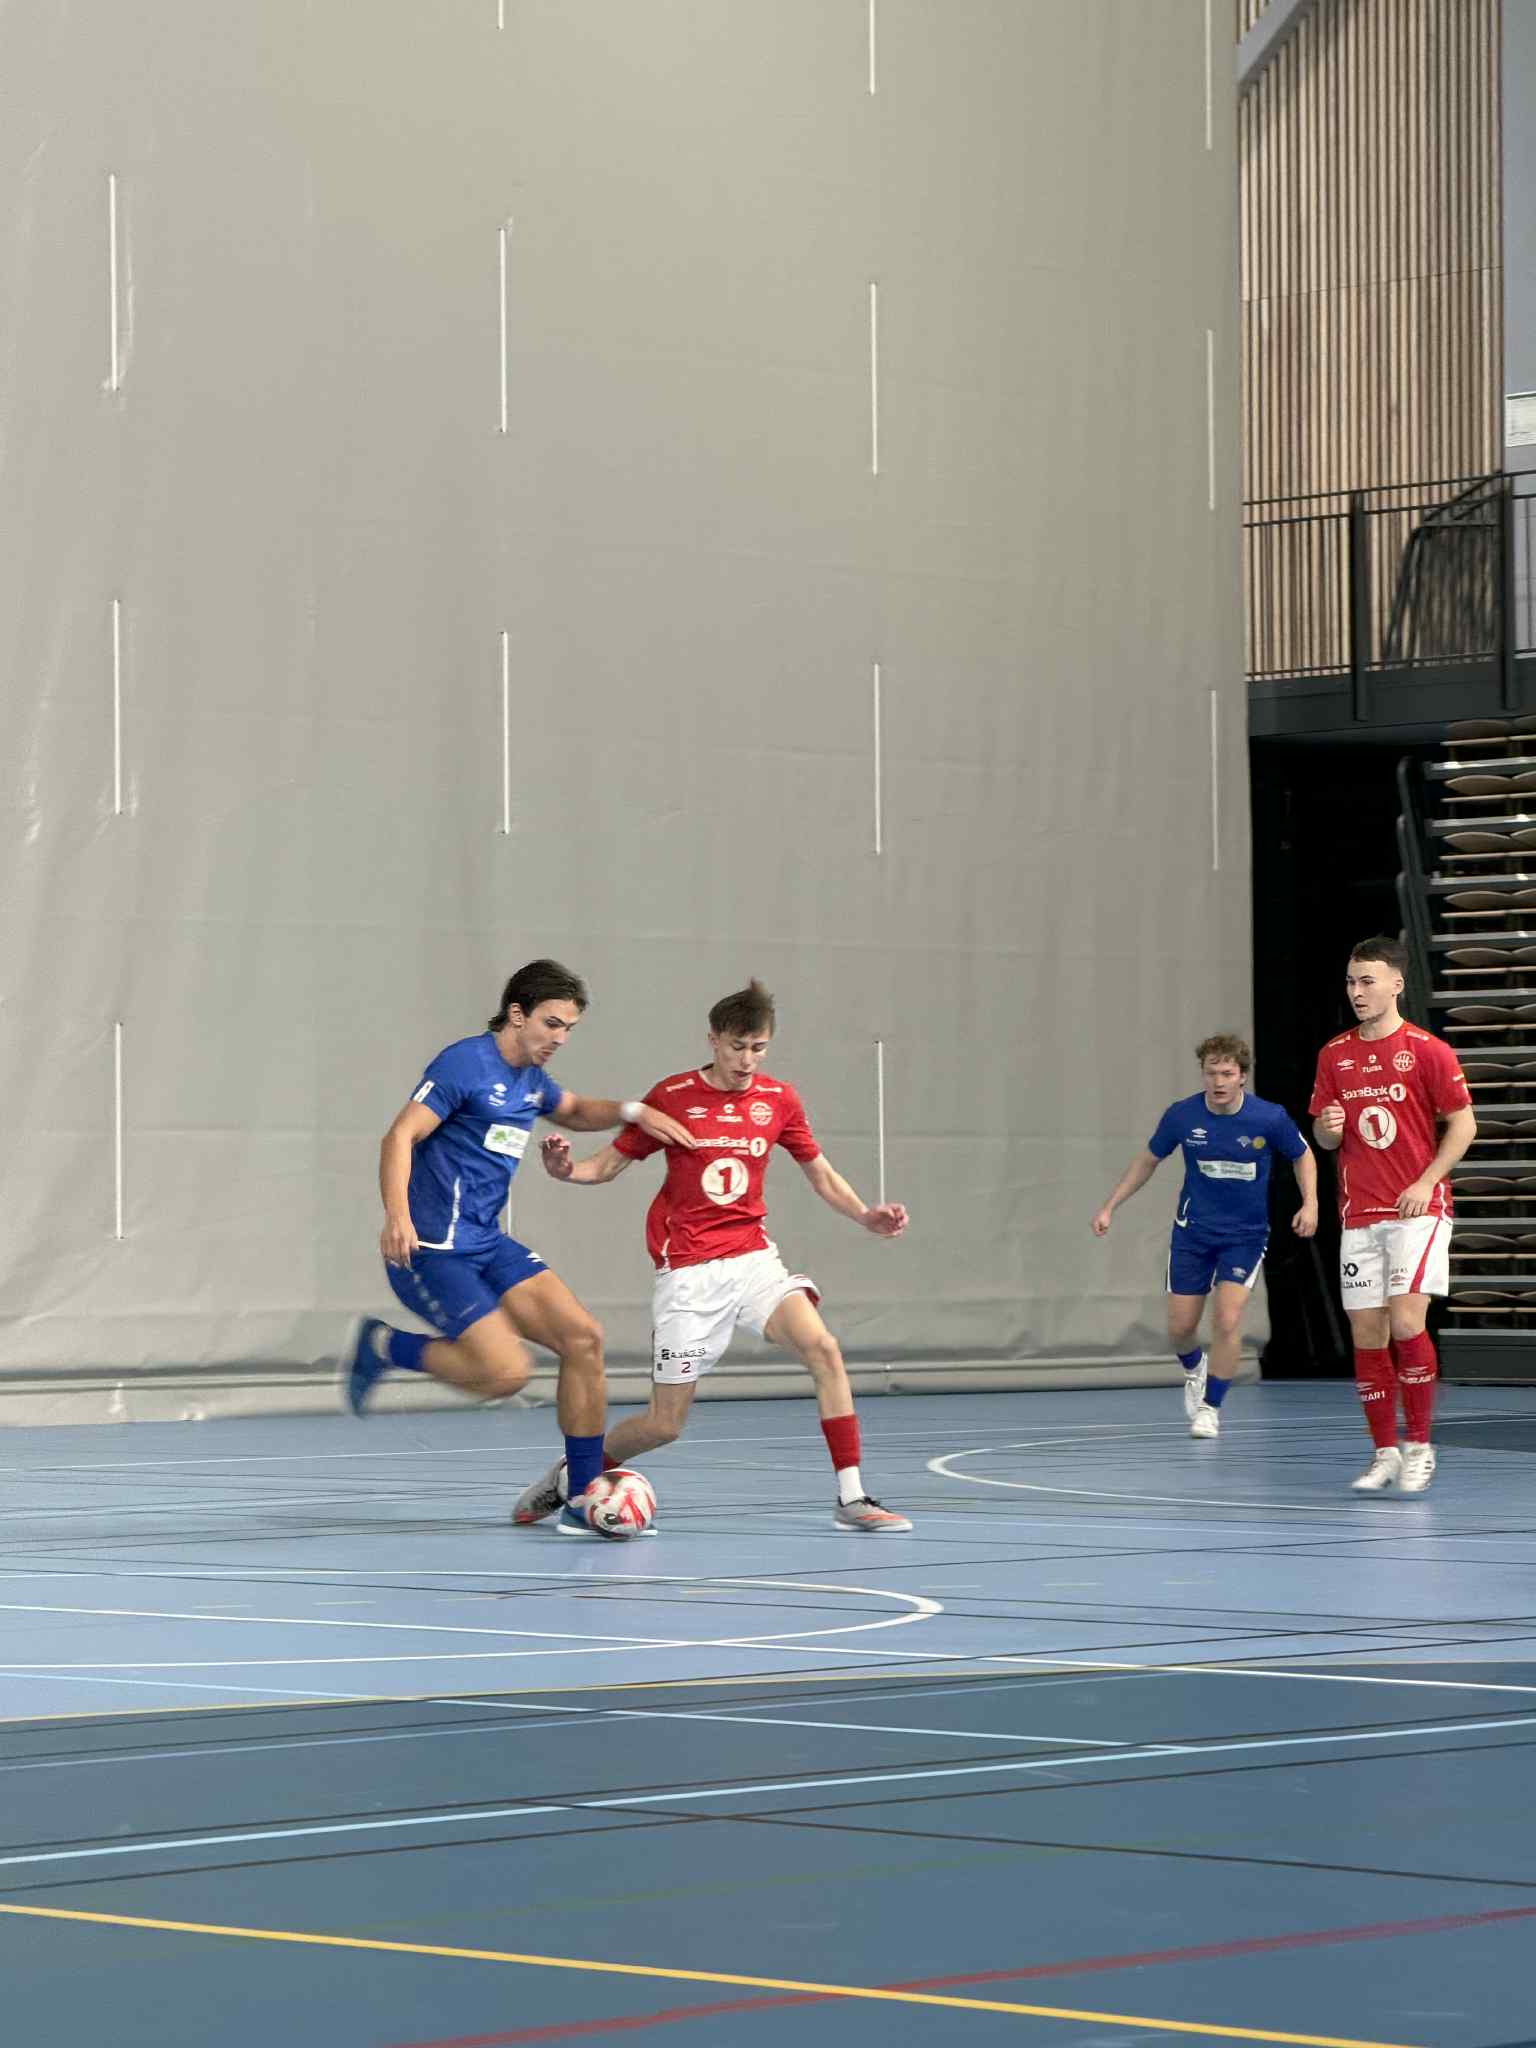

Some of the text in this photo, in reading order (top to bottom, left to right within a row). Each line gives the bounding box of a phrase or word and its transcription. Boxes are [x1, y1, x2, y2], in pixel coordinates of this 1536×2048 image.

[1366, 1114, 1383, 1141] 1
[718, 1167, 732, 1195] 1
[681, 1361, 691, 1373] 2
